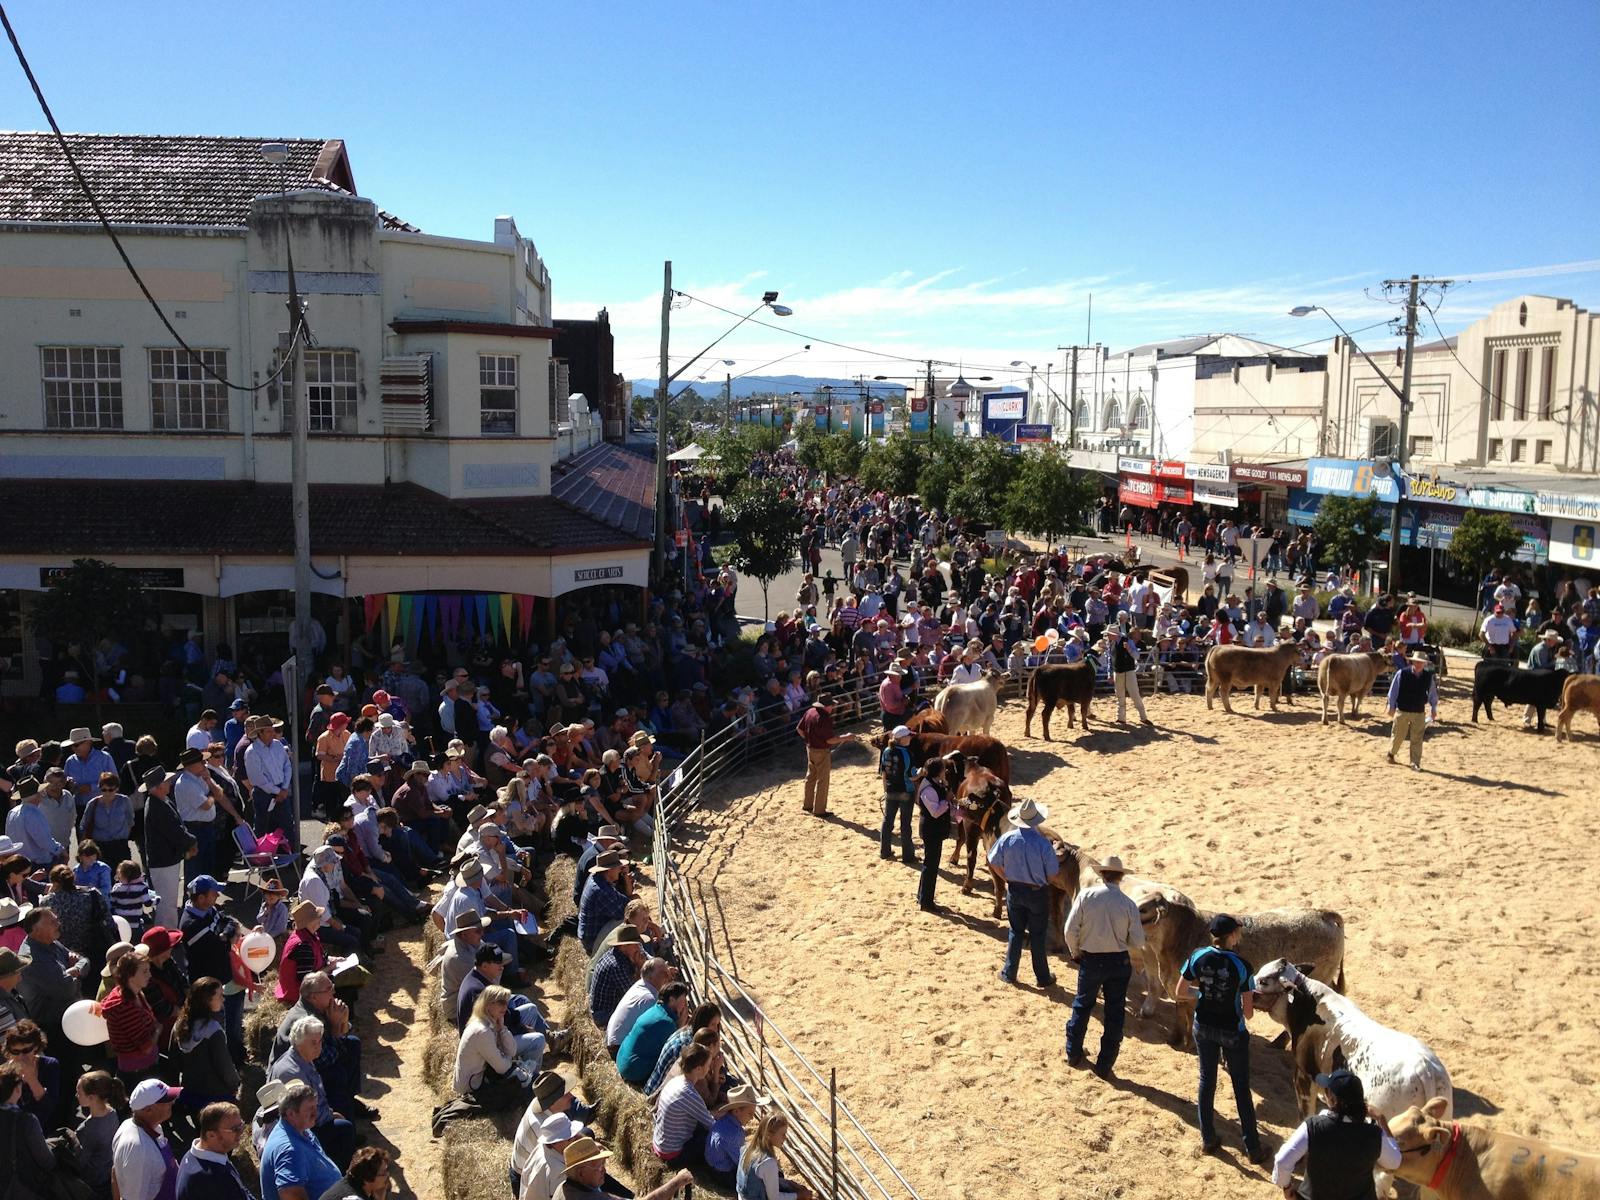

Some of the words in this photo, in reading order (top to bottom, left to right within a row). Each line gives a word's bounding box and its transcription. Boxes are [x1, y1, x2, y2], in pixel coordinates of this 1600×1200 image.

[1198, 468, 1228, 480] NEWSAGENCY
[1277, 471, 1302, 483] MENSLAND
[1540, 494, 1553, 512] Bill
[1558, 496, 1599, 518] Williams
[577, 570, 597, 580] SCHOOL
[598, 569, 605, 578] OF
[607, 567, 621, 577] ARTS
